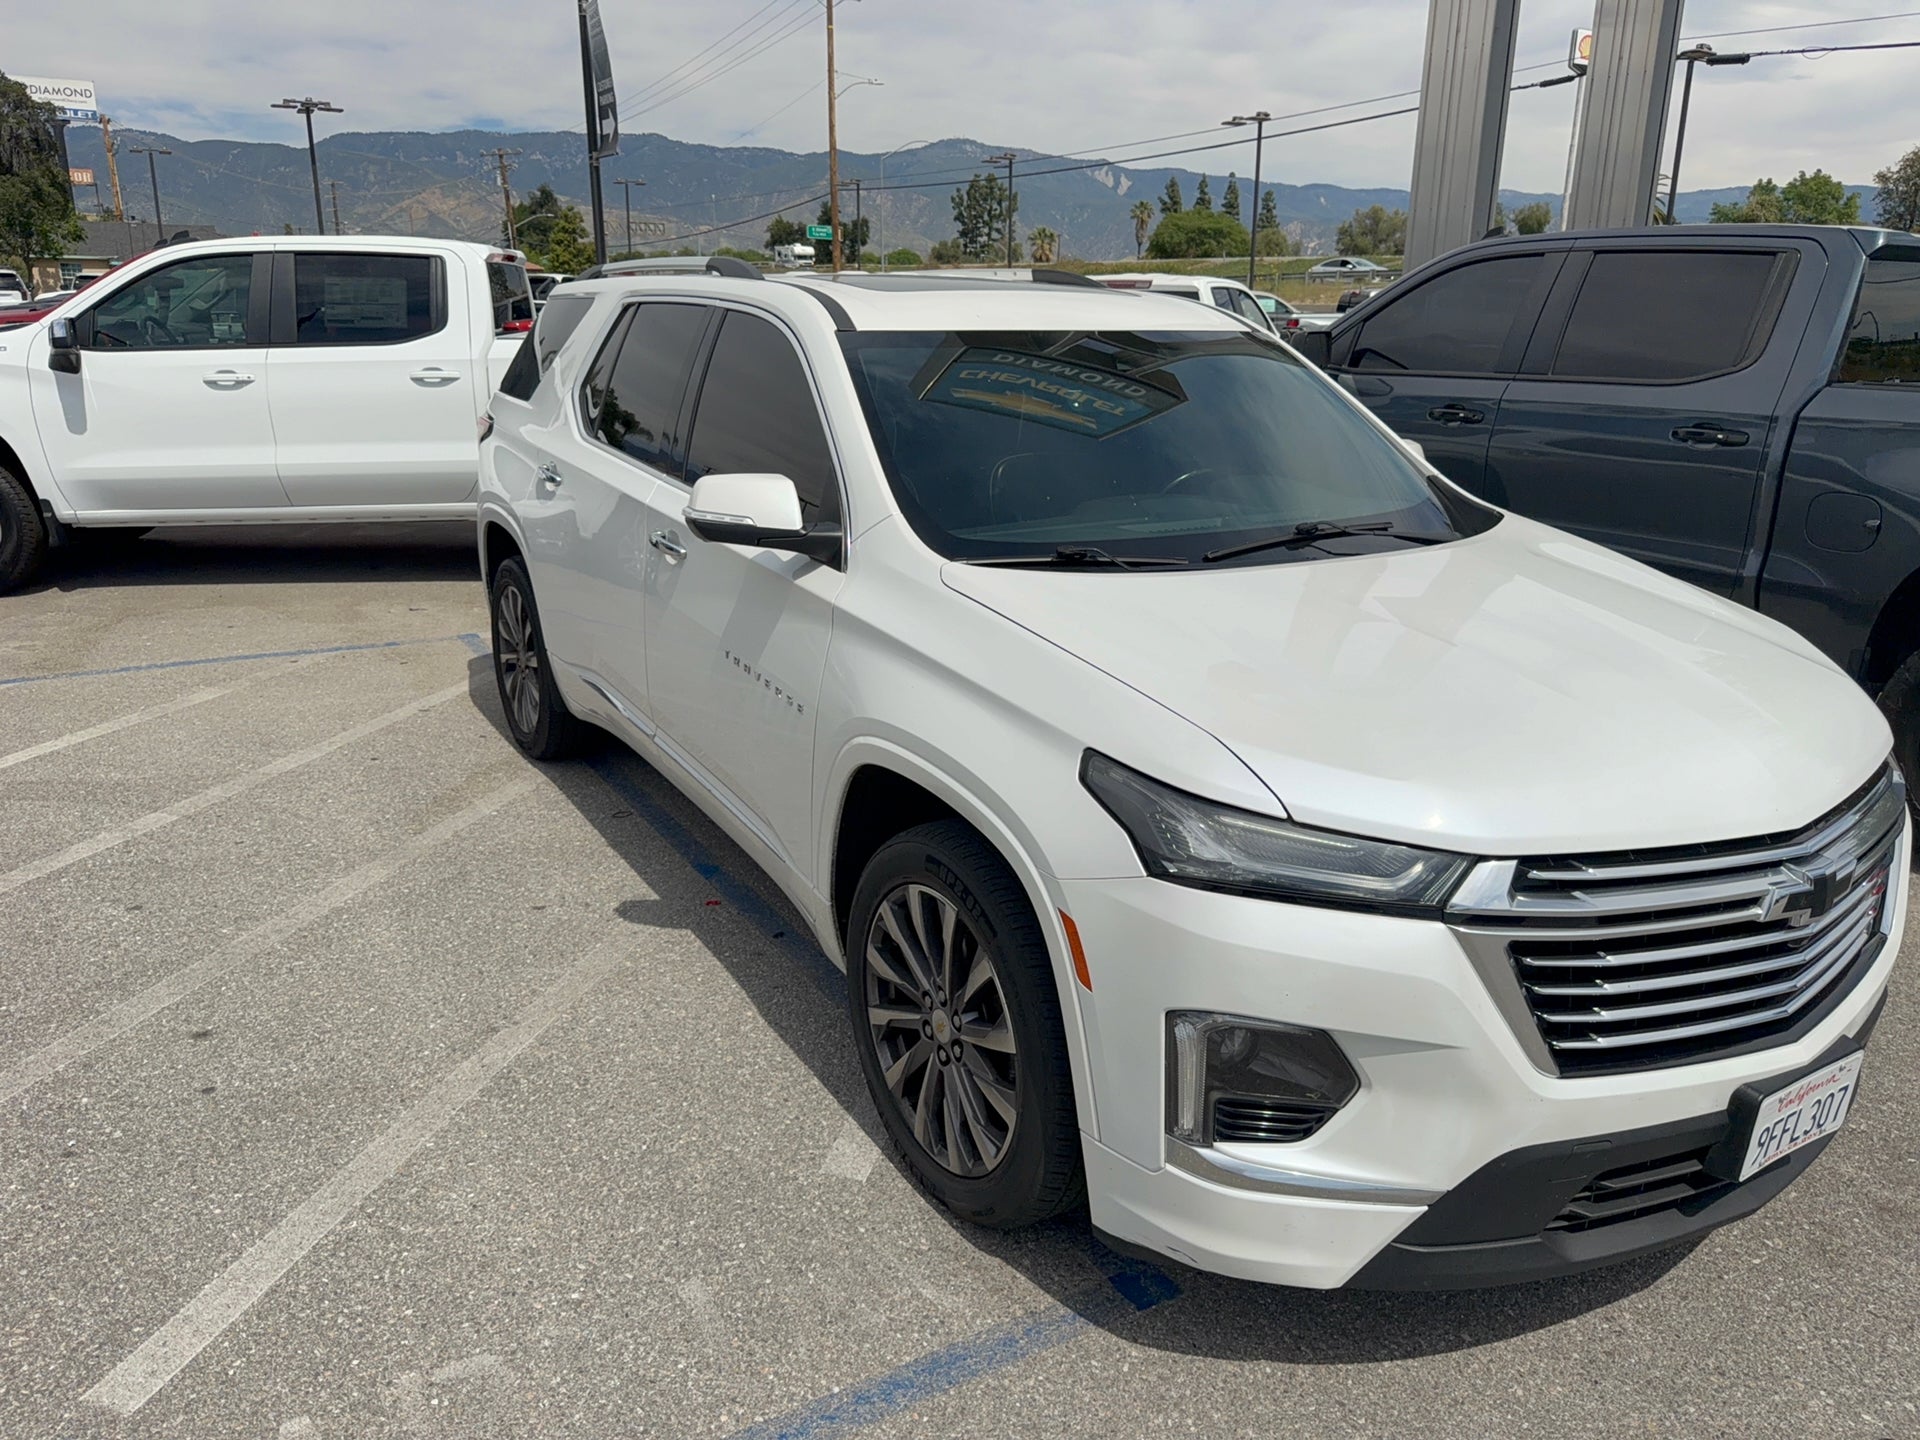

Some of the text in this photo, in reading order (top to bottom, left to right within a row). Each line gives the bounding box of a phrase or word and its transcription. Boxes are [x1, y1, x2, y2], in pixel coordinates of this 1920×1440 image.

[29, 85, 92, 98] DIAMOND
[725, 650, 805, 715] TRAVERSE
[1778, 1073, 1840, 1112] California
[1751, 1084, 1850, 1166] 9FFL307
